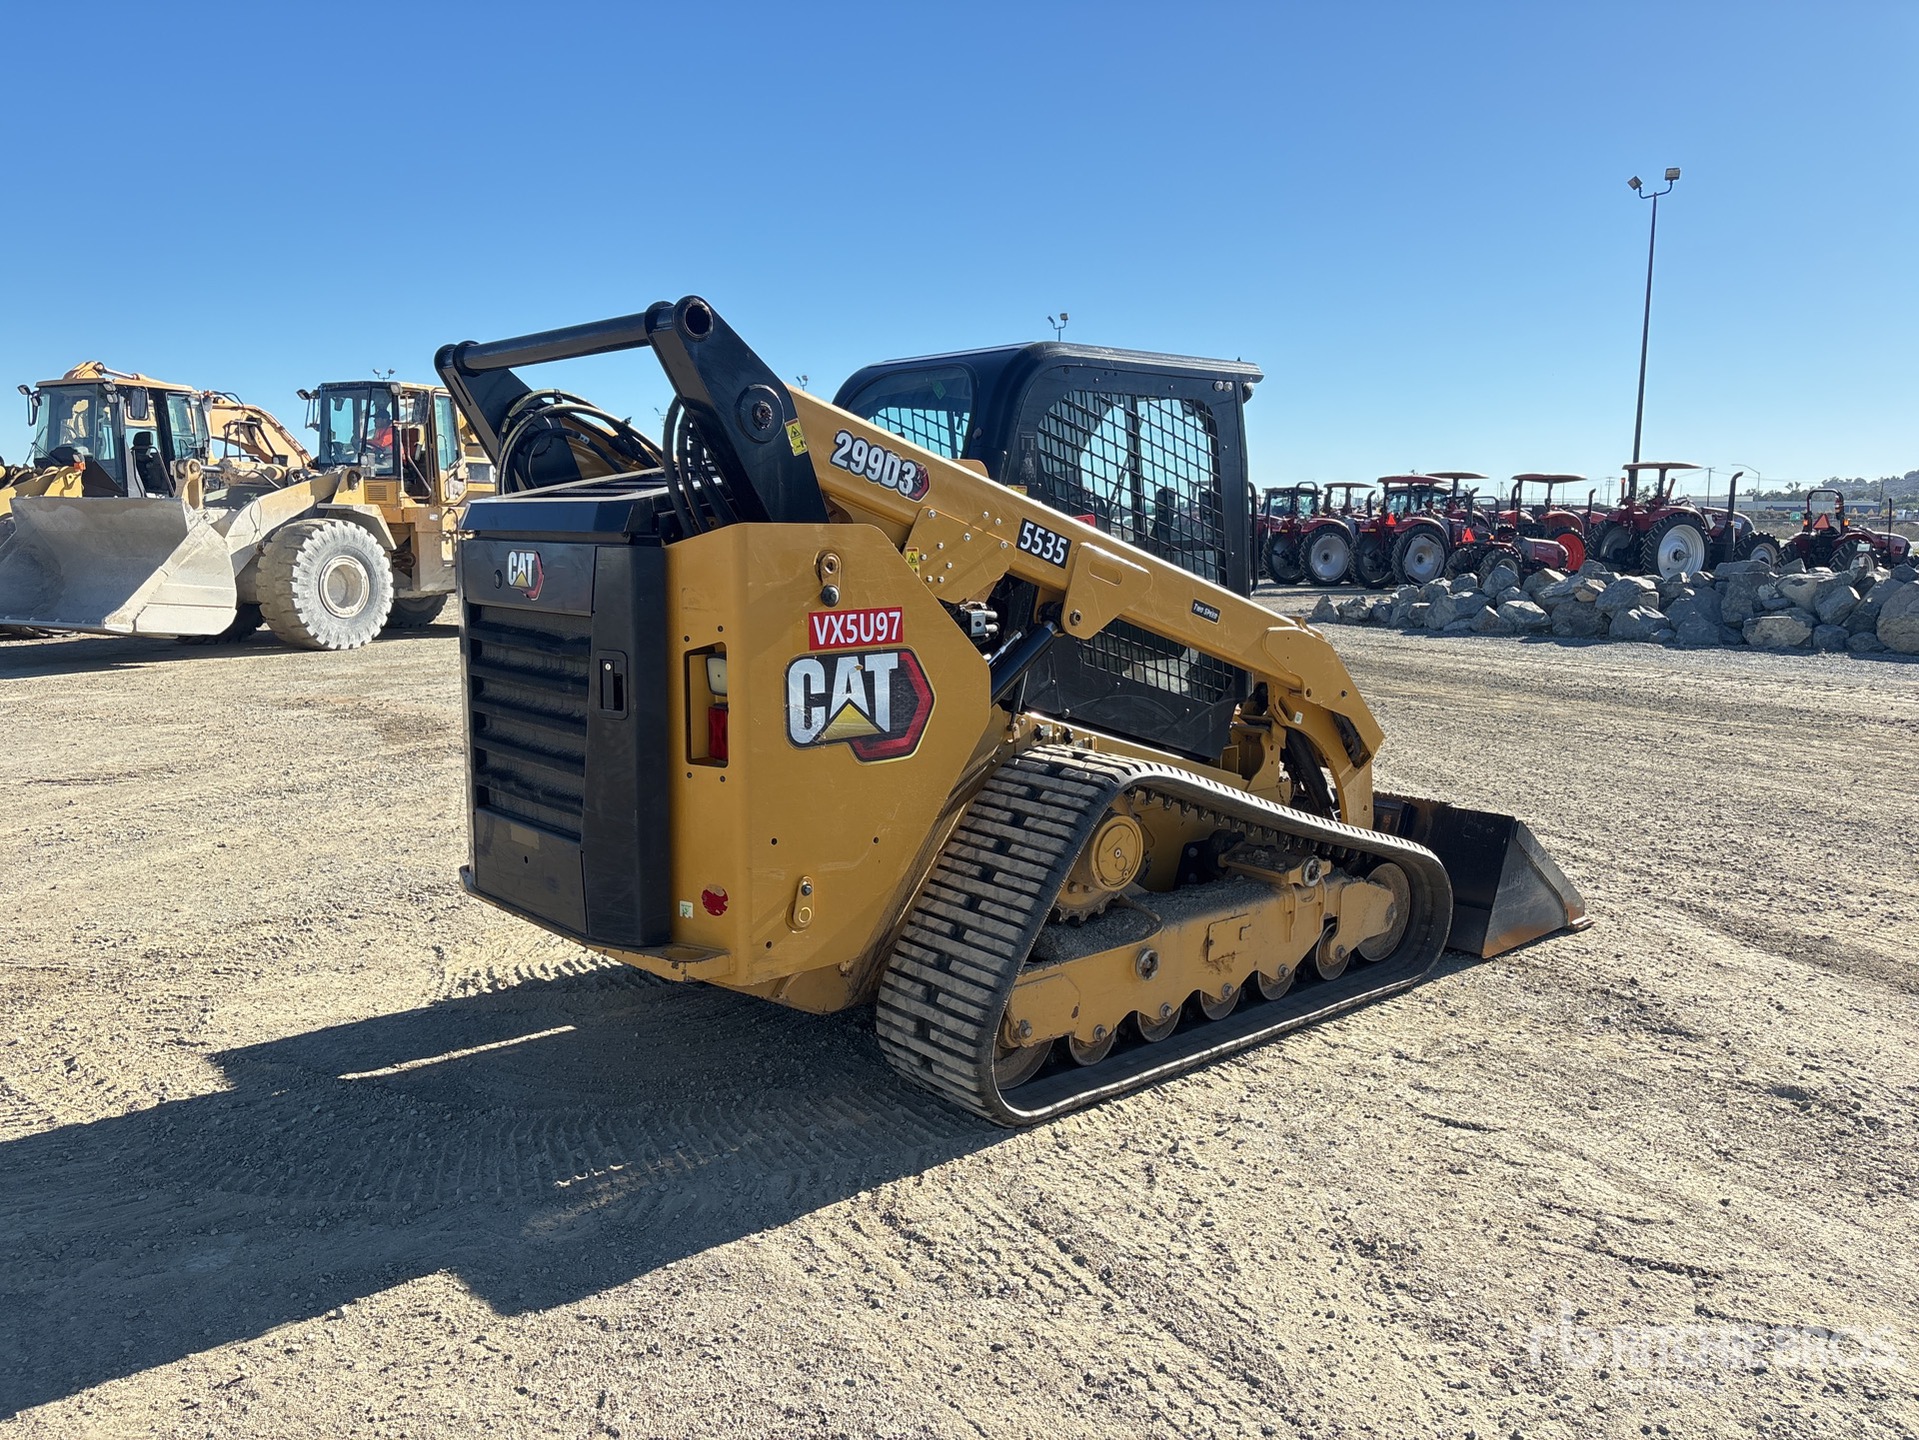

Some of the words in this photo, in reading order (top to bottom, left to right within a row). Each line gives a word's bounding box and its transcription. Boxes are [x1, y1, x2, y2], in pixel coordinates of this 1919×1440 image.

[831, 430, 918, 495] 299D3
[1019, 520, 1069, 565] 5535
[508, 551, 535, 588] CAT
[812, 611, 902, 646] VX5U97
[788, 652, 899, 744] CAT
